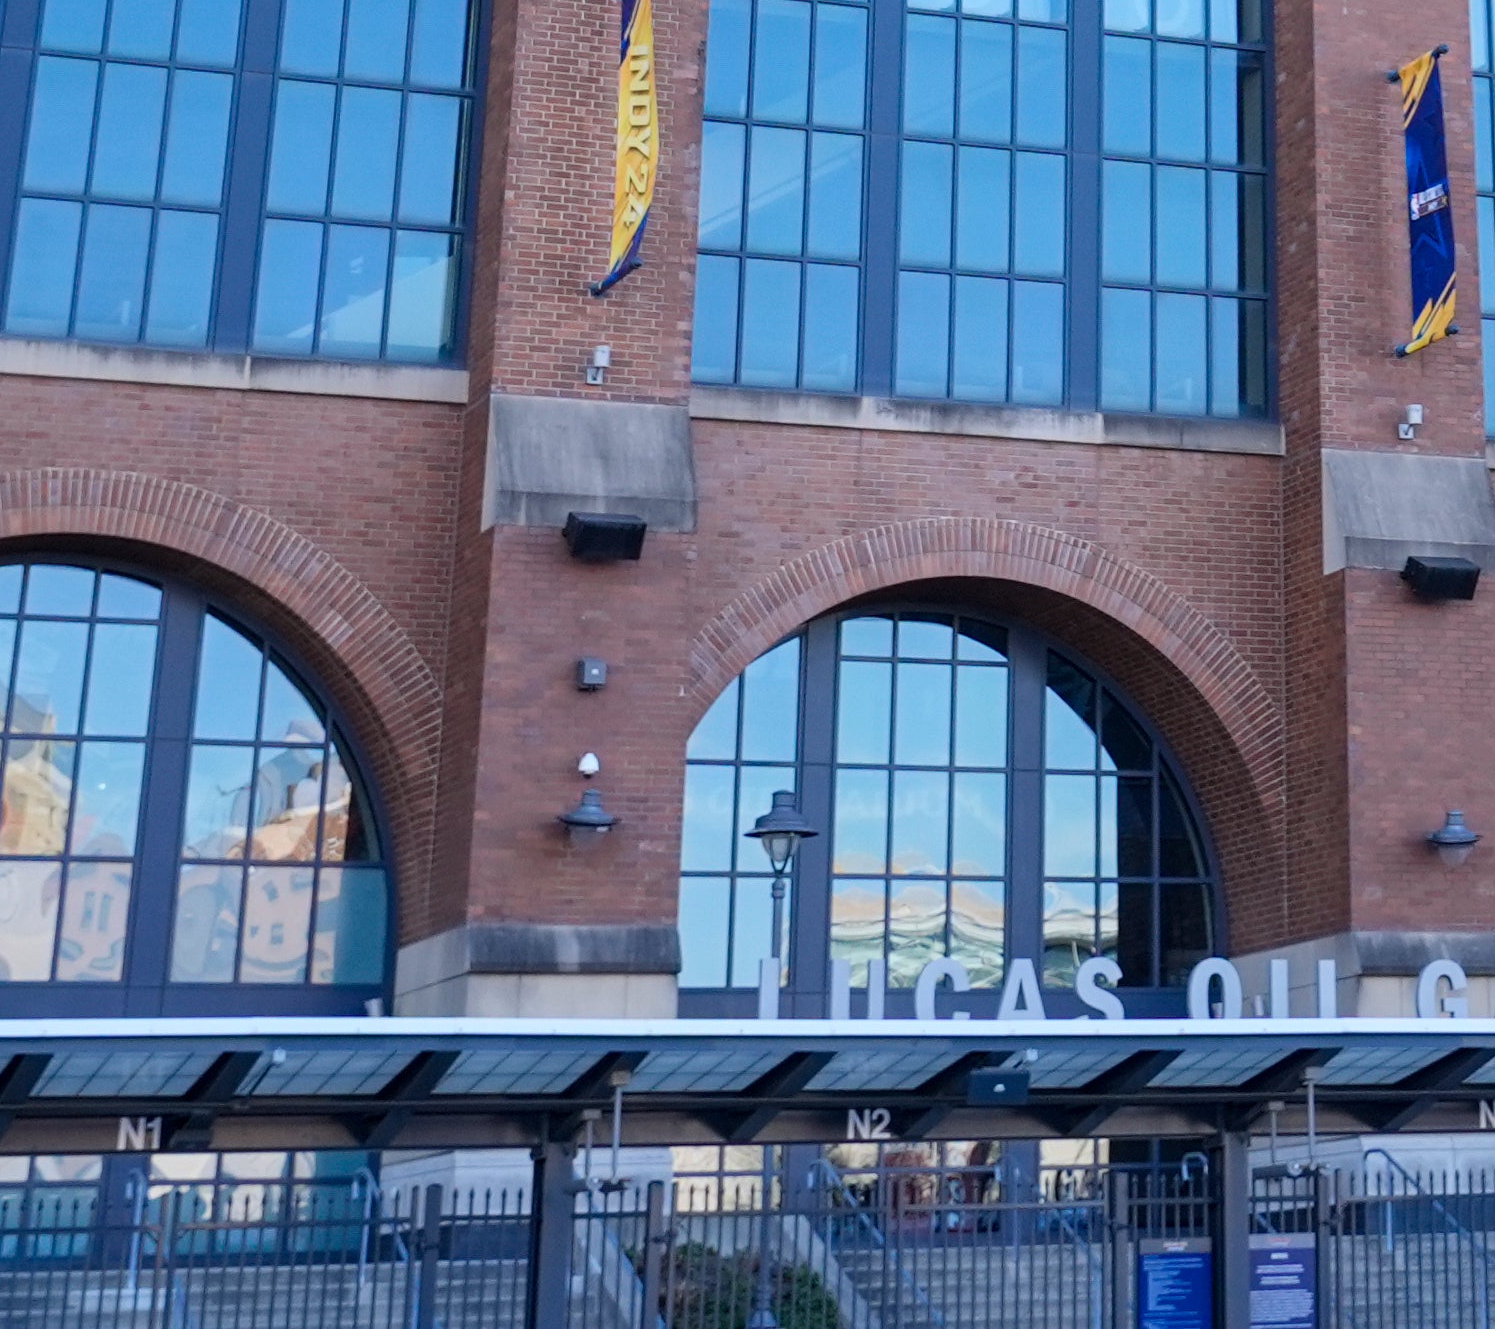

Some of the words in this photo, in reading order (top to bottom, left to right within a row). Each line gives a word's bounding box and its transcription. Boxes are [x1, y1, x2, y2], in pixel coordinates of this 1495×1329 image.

[628, 44, 650, 161] INDY
[625, 163, 650, 228] 24
[117, 1116, 163, 1151] N1
[847, 1108, 893, 1141] N2
